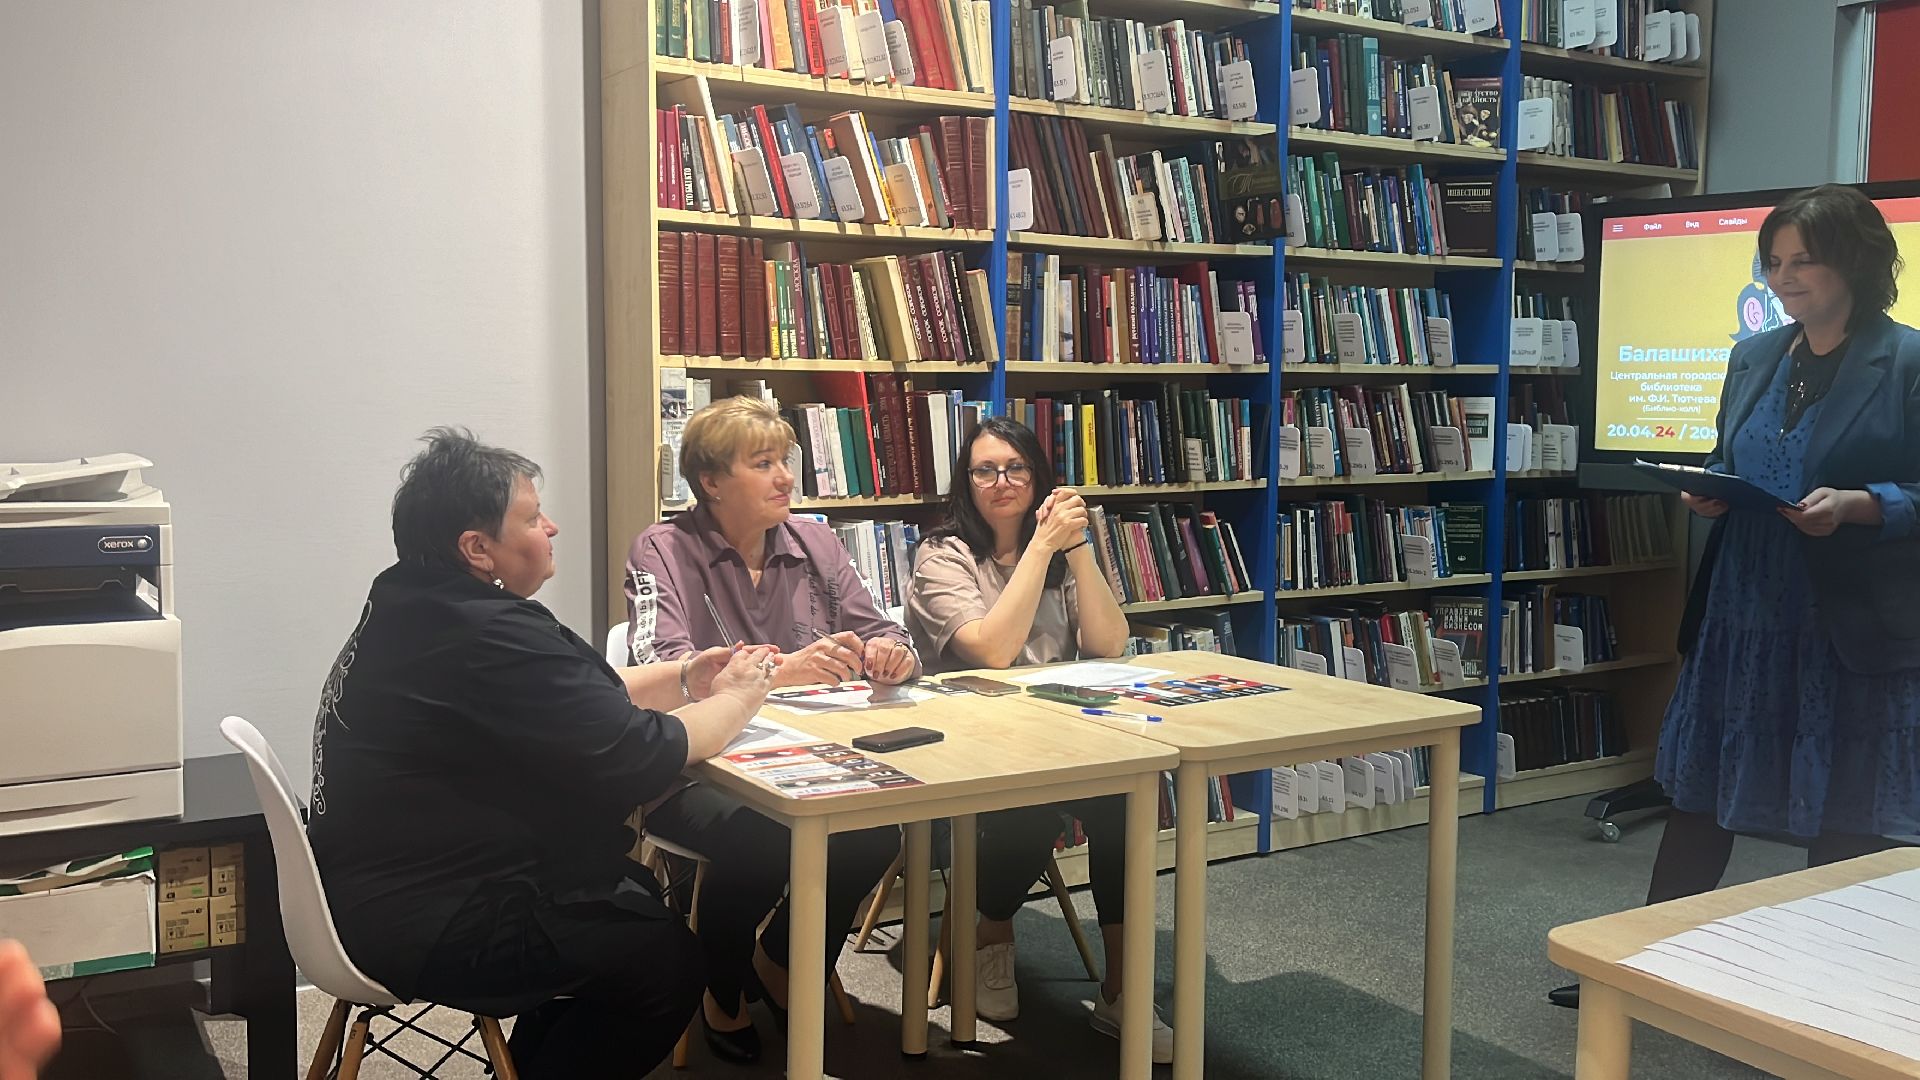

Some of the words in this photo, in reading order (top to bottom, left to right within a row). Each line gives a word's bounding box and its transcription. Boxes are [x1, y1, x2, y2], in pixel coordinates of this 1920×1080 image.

[1685, 220, 1700, 229] Вид
[1718, 217, 1748, 226] Слайды
[1643, 223, 1662, 232] Файл
[1619, 345, 1730, 362] Балашиха
[1611, 371, 1677, 381] Центральная
[1640, 382, 1702, 392] библиотека
[1629, 395, 1646, 403] им.
[1672, 394, 1717, 404] Тютчева
[1607, 423, 1676, 438] 20.04.24
[104, 540, 134, 549] xerox
[1435, 608, 1483, 617] УПРАВЛЕНИЕ
[1444, 622, 1483, 631] БИЗНЕСОМ
